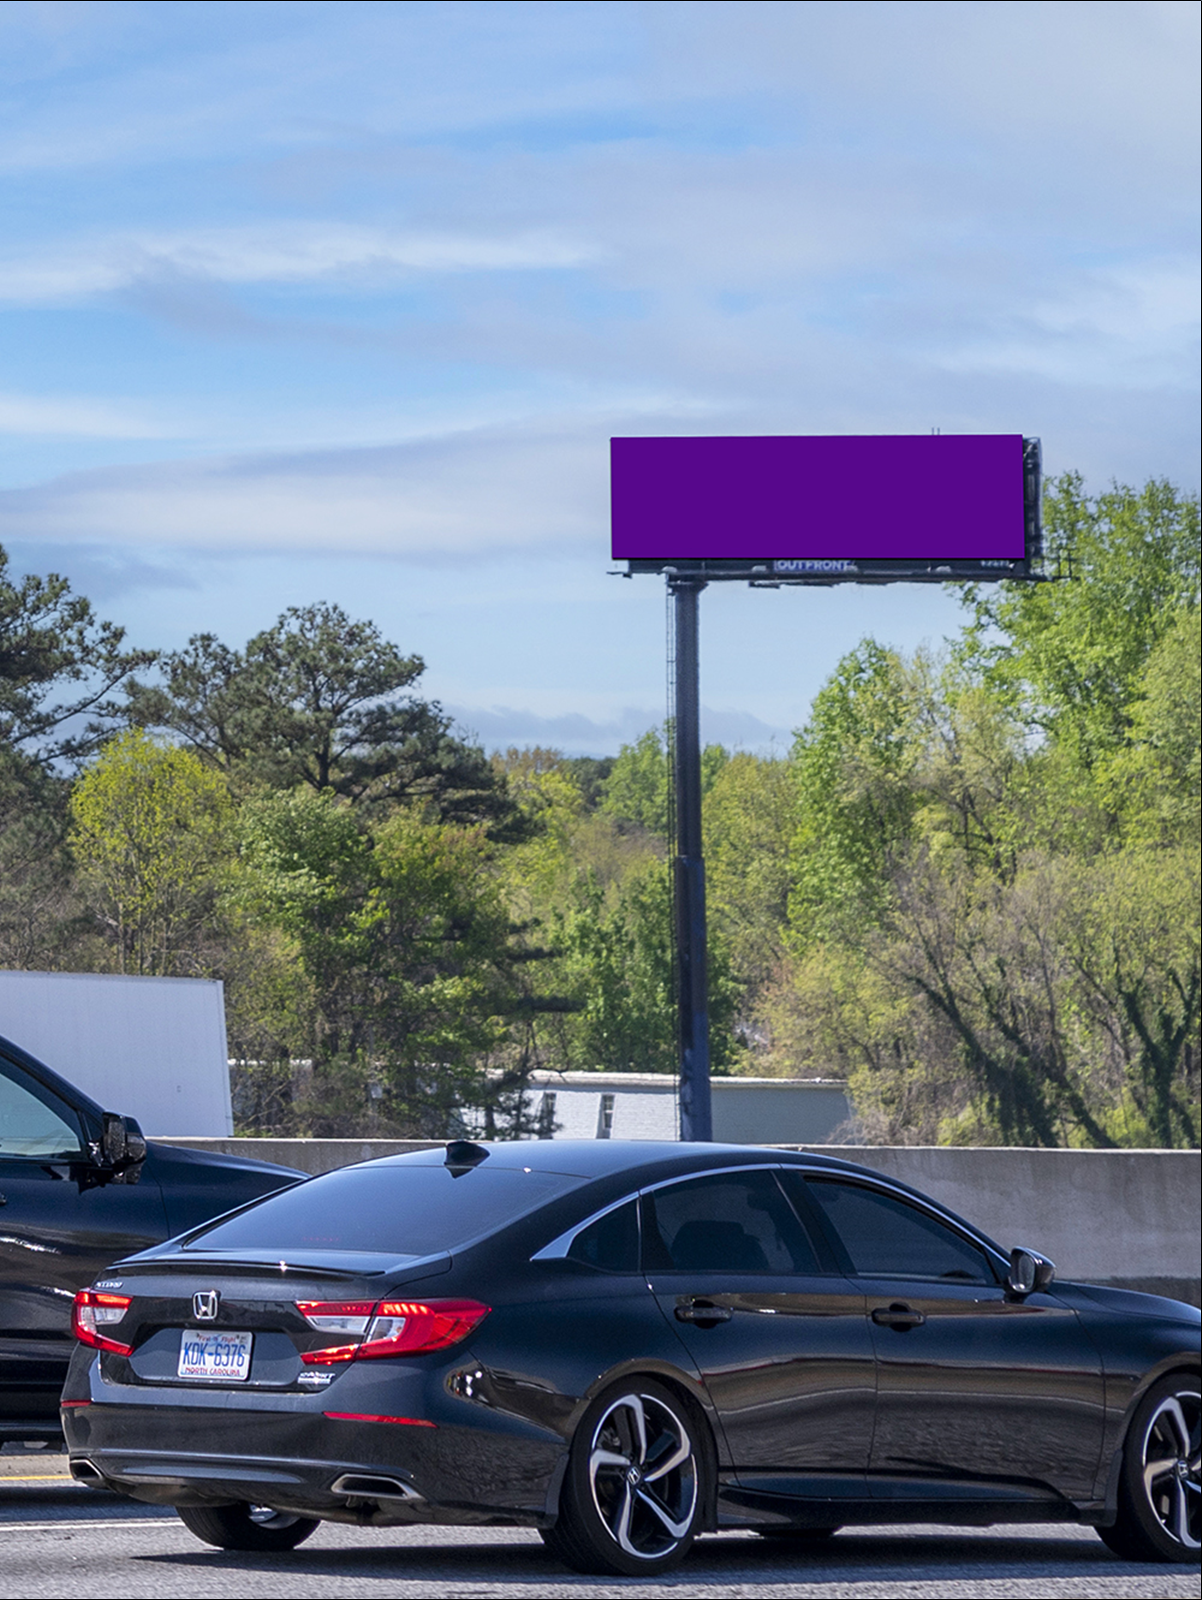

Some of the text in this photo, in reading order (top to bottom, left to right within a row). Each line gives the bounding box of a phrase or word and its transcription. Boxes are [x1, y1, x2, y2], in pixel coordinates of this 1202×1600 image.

[183, 1342, 246, 1367] KDK-6376
[186, 1367, 240, 1376] NORTH CAROLINA
